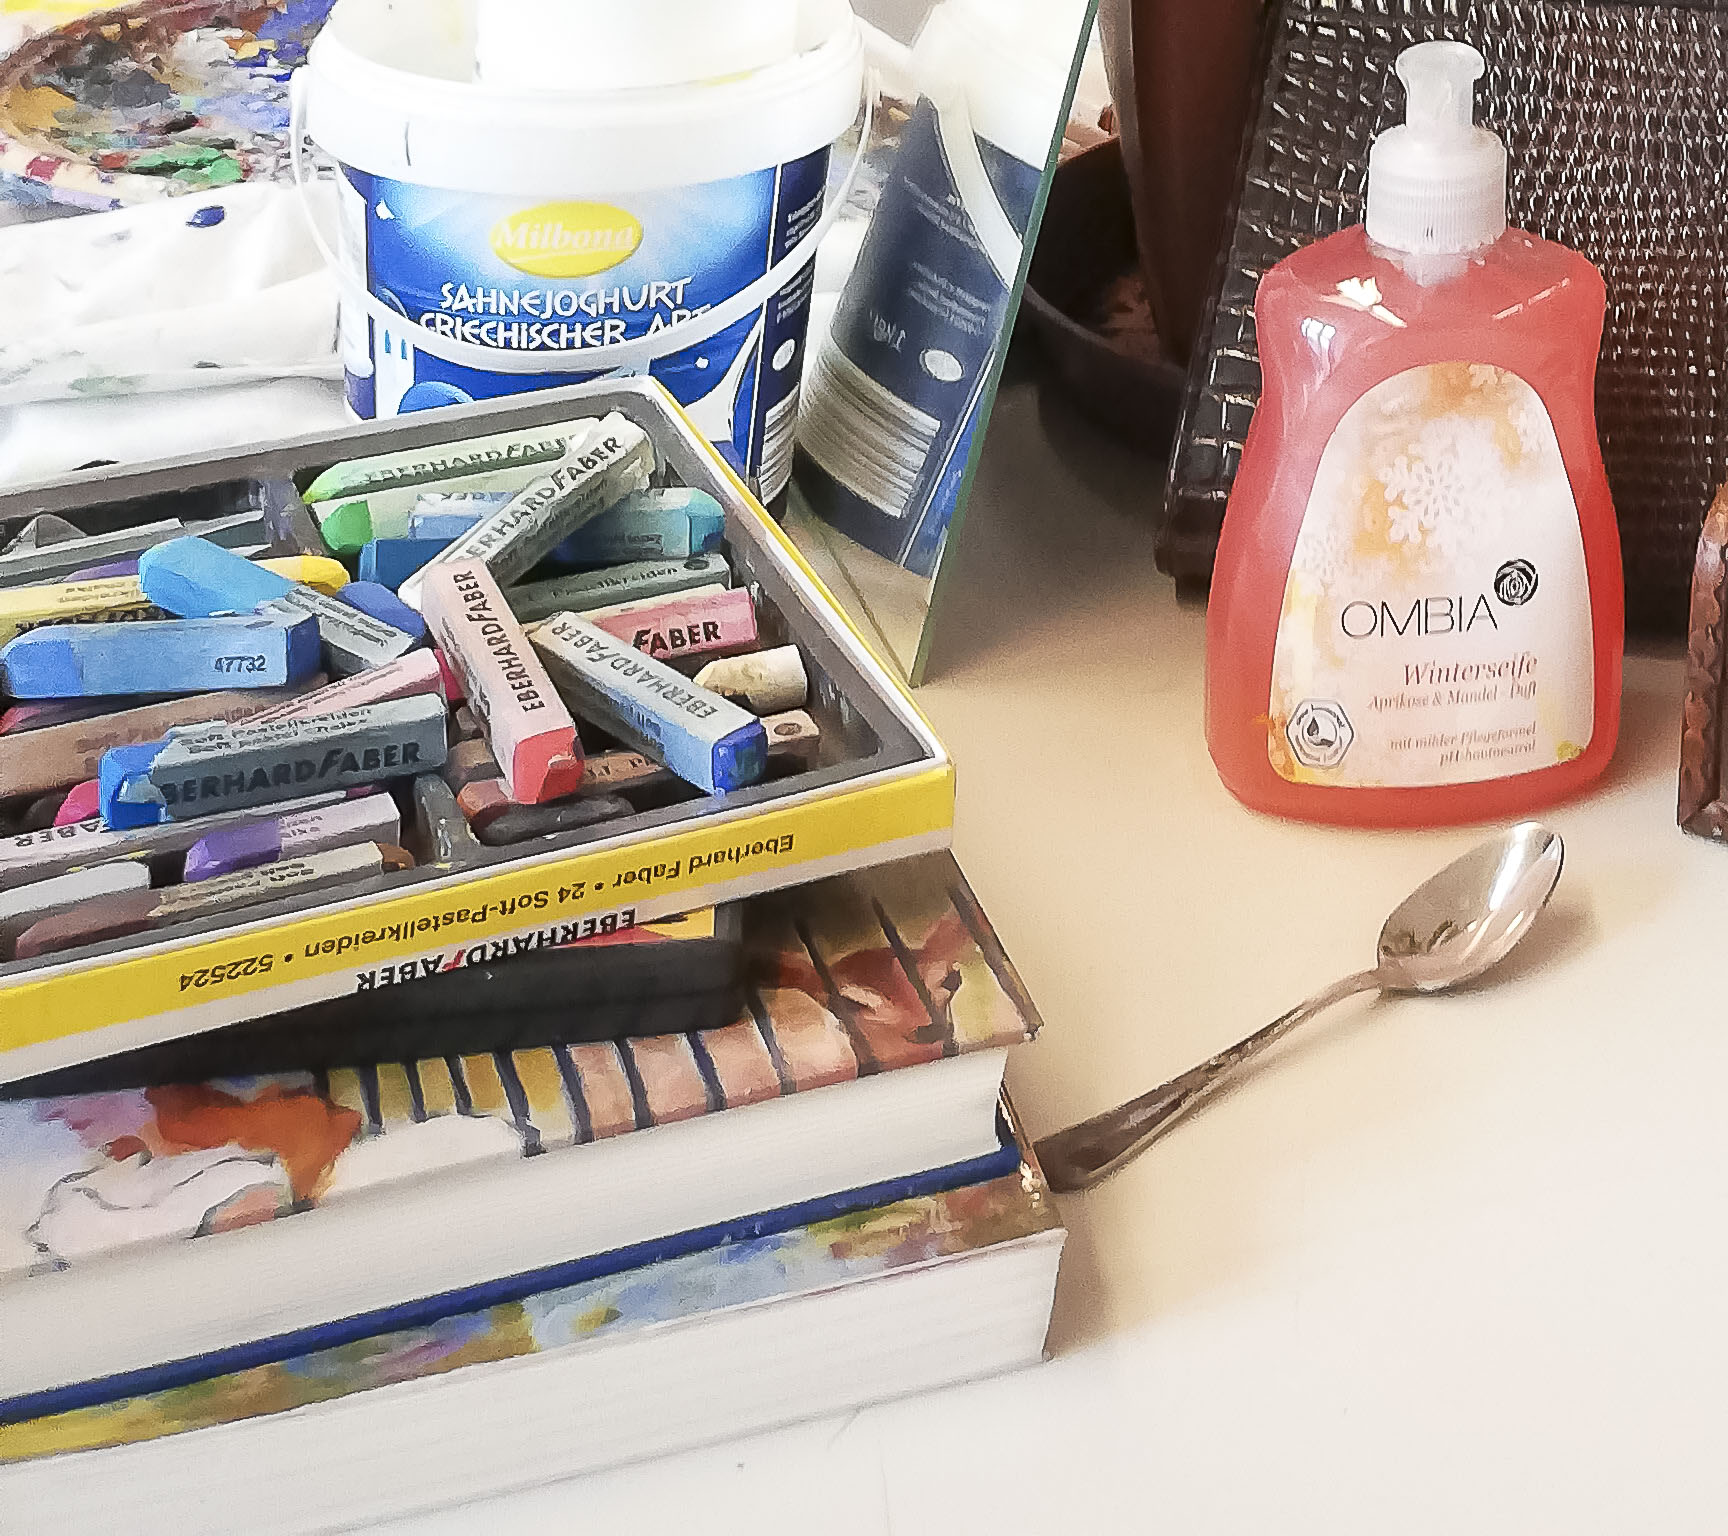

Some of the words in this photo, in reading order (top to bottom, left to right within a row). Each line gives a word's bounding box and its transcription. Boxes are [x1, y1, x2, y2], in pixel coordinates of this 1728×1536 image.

[437, 276, 694, 319] SAHNEJOGHURT
[632, 620, 722, 654] FABER
[1341, 593, 1499, 639] OMBIA
[453, 569, 546, 714] EBERHARDFABER
[551, 620, 719, 720] EBERHARDFABER
[1403, 650, 1538, 686] Winterseife
[611, 859, 681, 889] Faber
[688, 833, 795, 875] Eberhard
[557, 881, 587, 904] 24
[304, 889, 549, 958] Soft-Pastellkreiden
[178, 952, 275, 993] 522524
